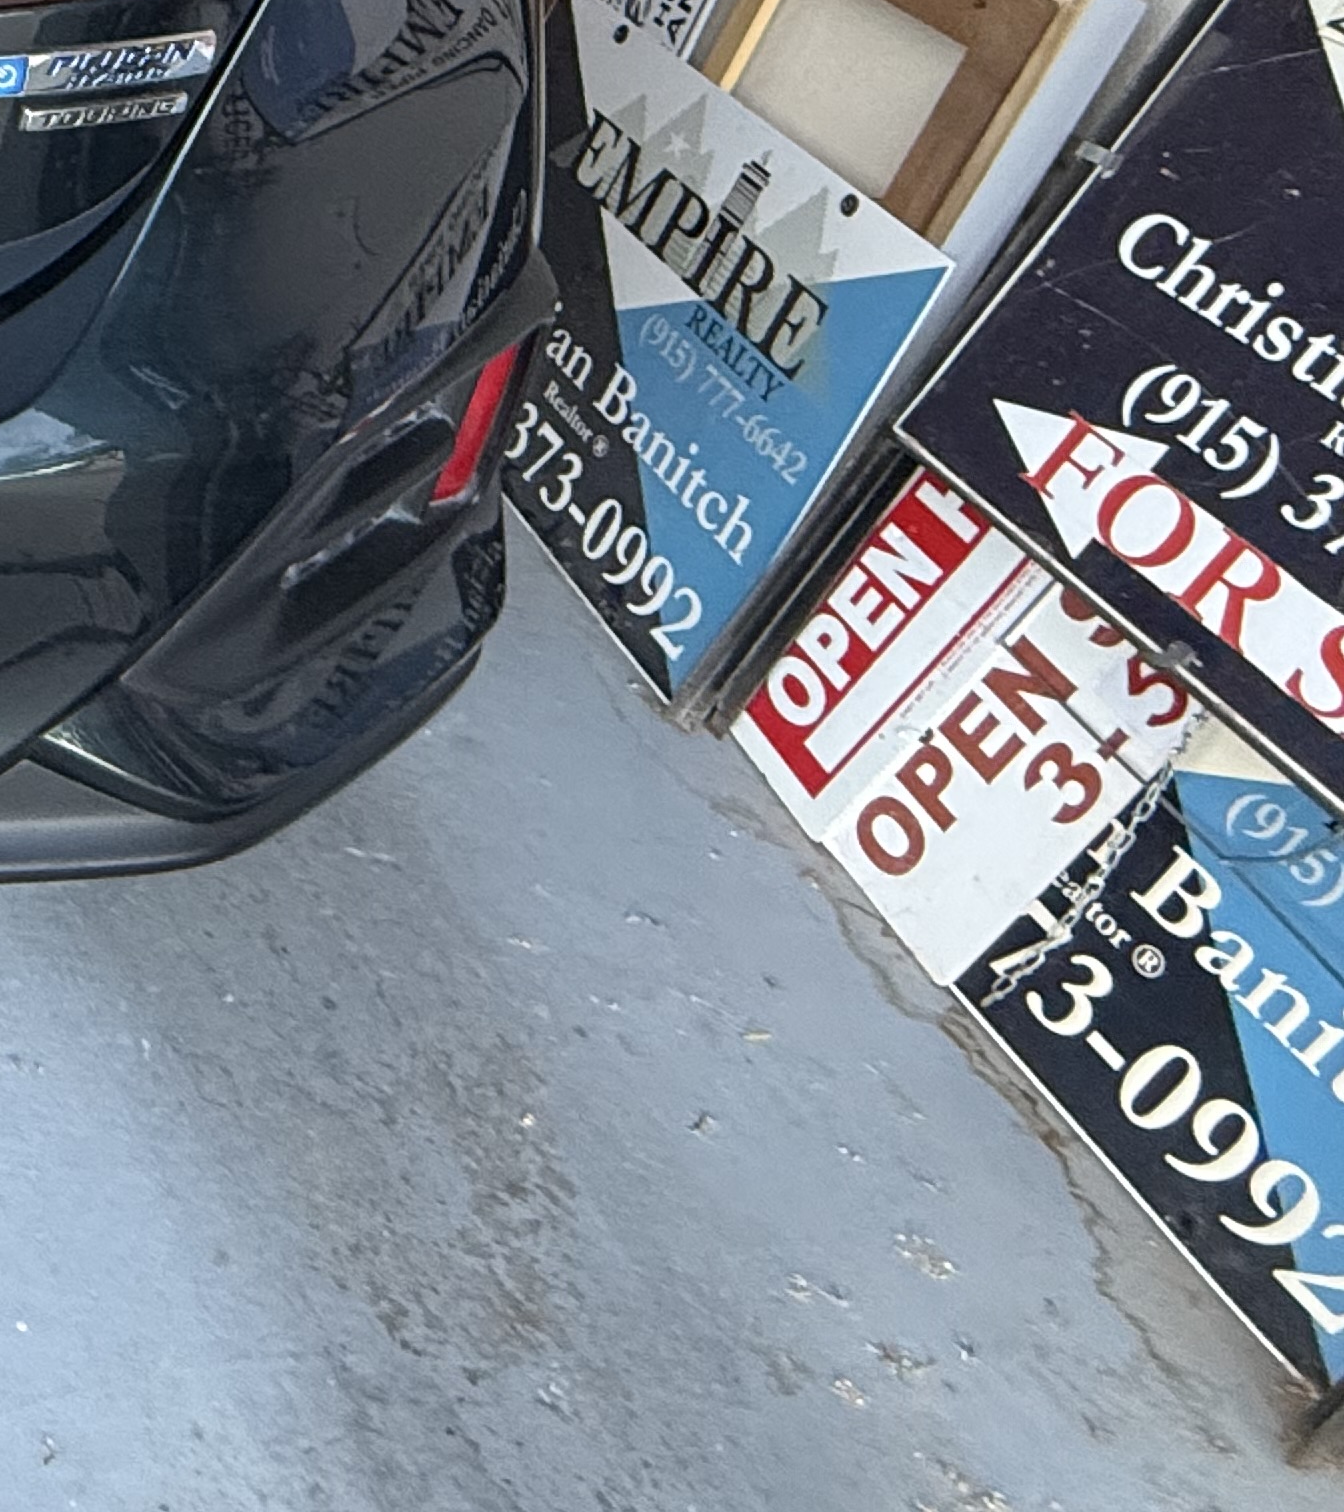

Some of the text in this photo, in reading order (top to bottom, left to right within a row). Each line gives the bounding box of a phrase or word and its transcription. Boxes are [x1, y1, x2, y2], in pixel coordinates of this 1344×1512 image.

[576, 107, 828, 380] EMPIRE
[543, 380, 593, 445] Realtor
[545, 326, 754, 567] an Banitch
[639, 313, 807, 485] (915) 777-6642
[684, 304, 785, 403] REALTY
[1122, 364, 1280, 500] (915)
[504, 402, 702, 661] 373-0992
[768, 522, 944, 726] OPEN
[1018, 409, 1282, 655] FOR
[857, 634, 1079, 876] OPEN
[1225, 793, 1344, 908] (915)
